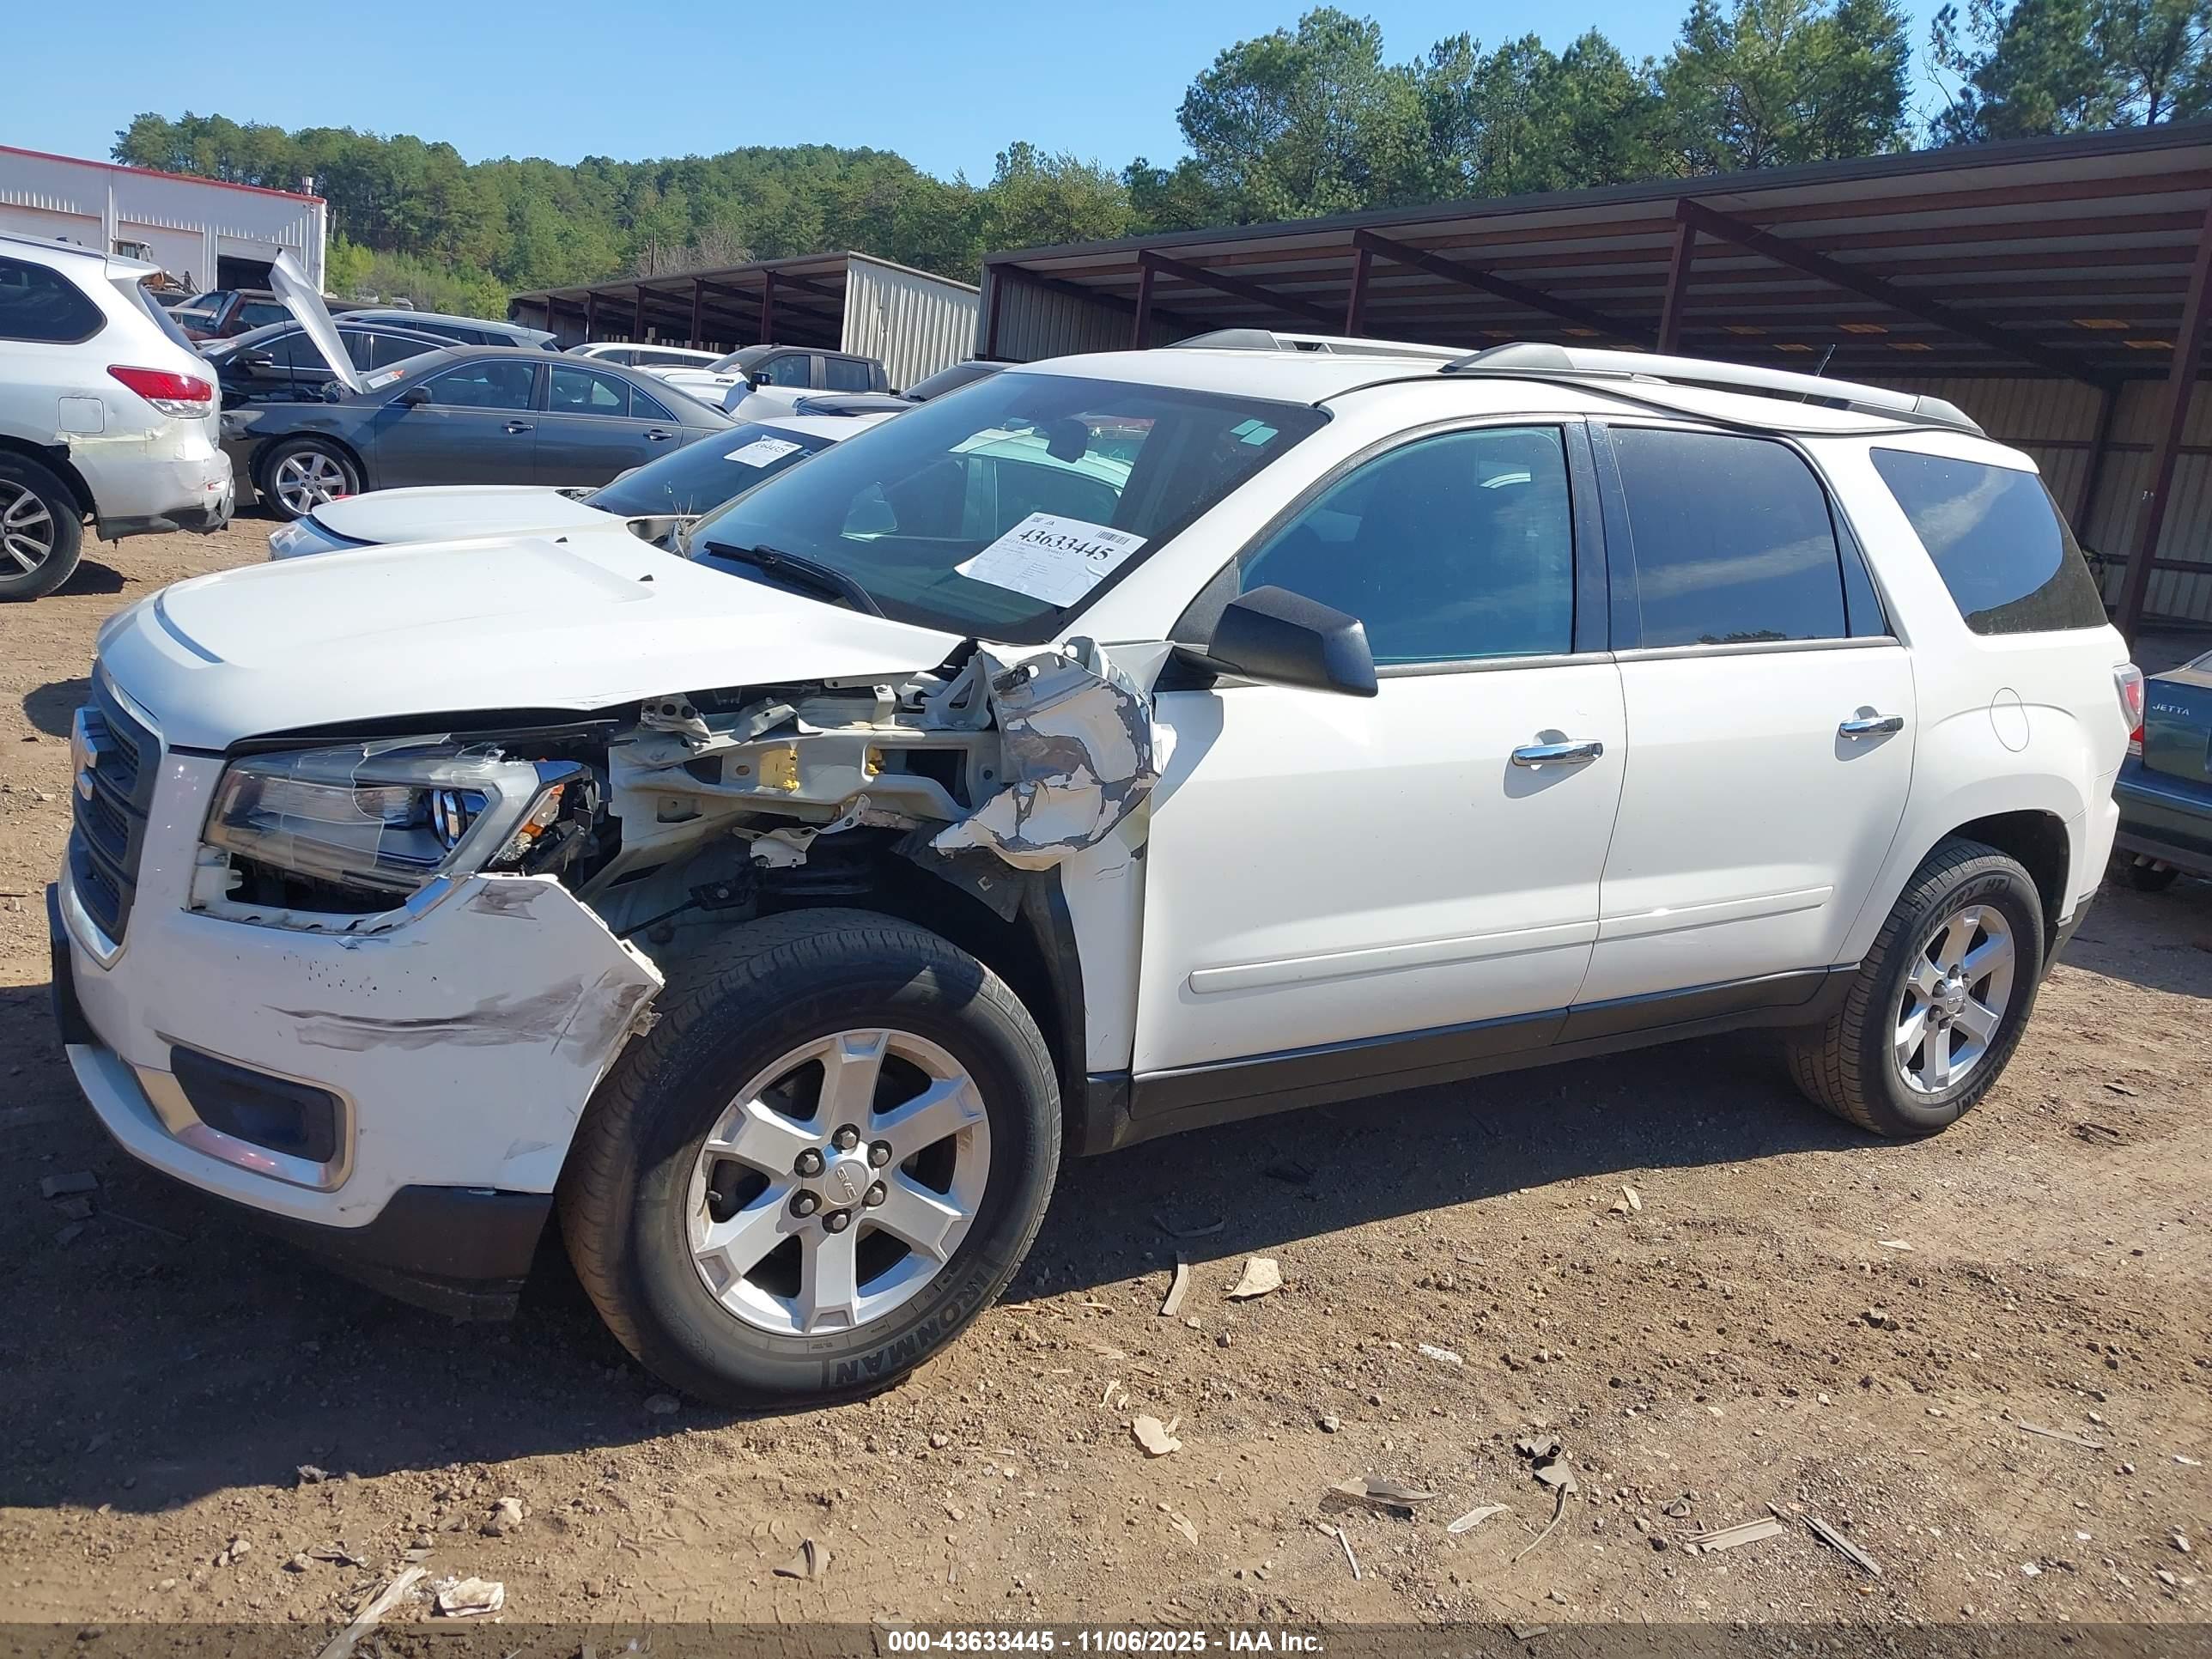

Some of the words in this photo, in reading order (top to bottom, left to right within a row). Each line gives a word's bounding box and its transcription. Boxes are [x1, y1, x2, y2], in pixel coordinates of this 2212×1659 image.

[1018, 528, 1115, 562] 43633445
[2152, 703, 2190, 716] JETTA
[836, 1166, 857, 1200] GMC
[836, 1269, 991, 1384] IRONMAN
